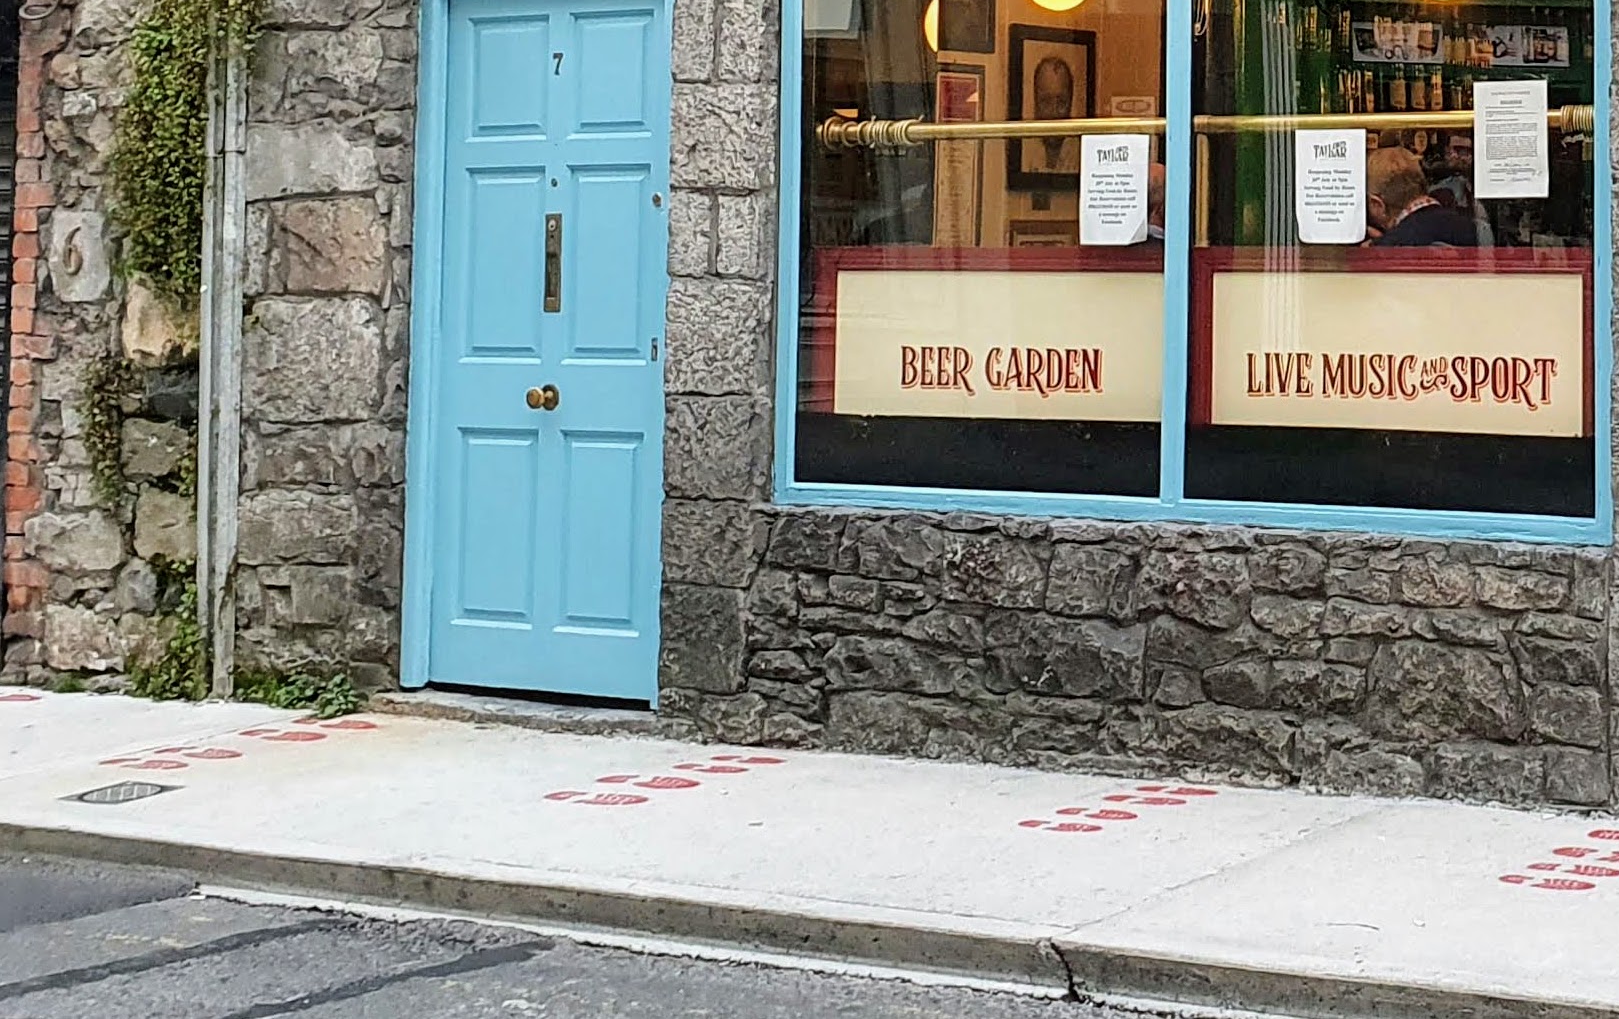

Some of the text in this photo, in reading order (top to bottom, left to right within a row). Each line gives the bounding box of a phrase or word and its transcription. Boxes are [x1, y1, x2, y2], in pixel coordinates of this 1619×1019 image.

[552, 52, 565, 76] 7
[900, 345, 1103, 399] BEER GARDEN
[1246, 352, 1558, 412] LIVE MUSIC AND SPORT
